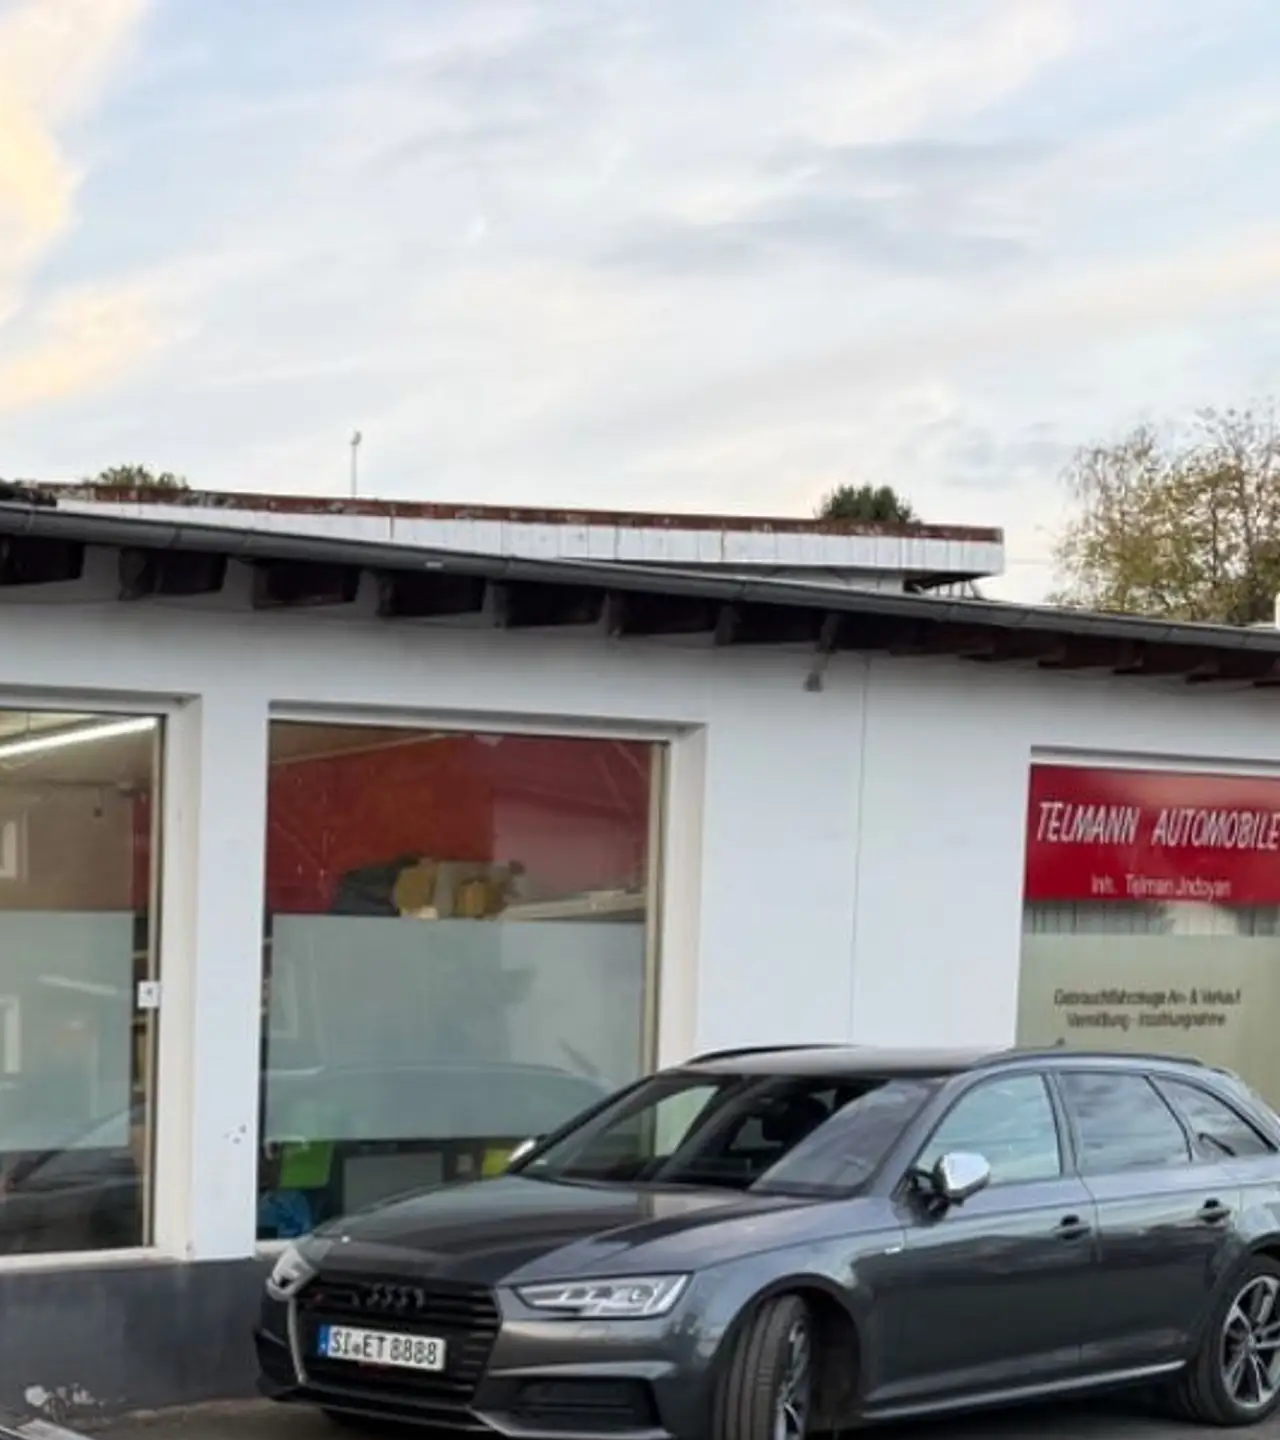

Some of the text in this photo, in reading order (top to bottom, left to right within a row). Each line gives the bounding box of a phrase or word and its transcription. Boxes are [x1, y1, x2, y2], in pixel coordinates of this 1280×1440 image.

[1037, 801, 1280, 850] TELMANN AUTOMOBILE
[390, 1337, 437, 1365] 8888
